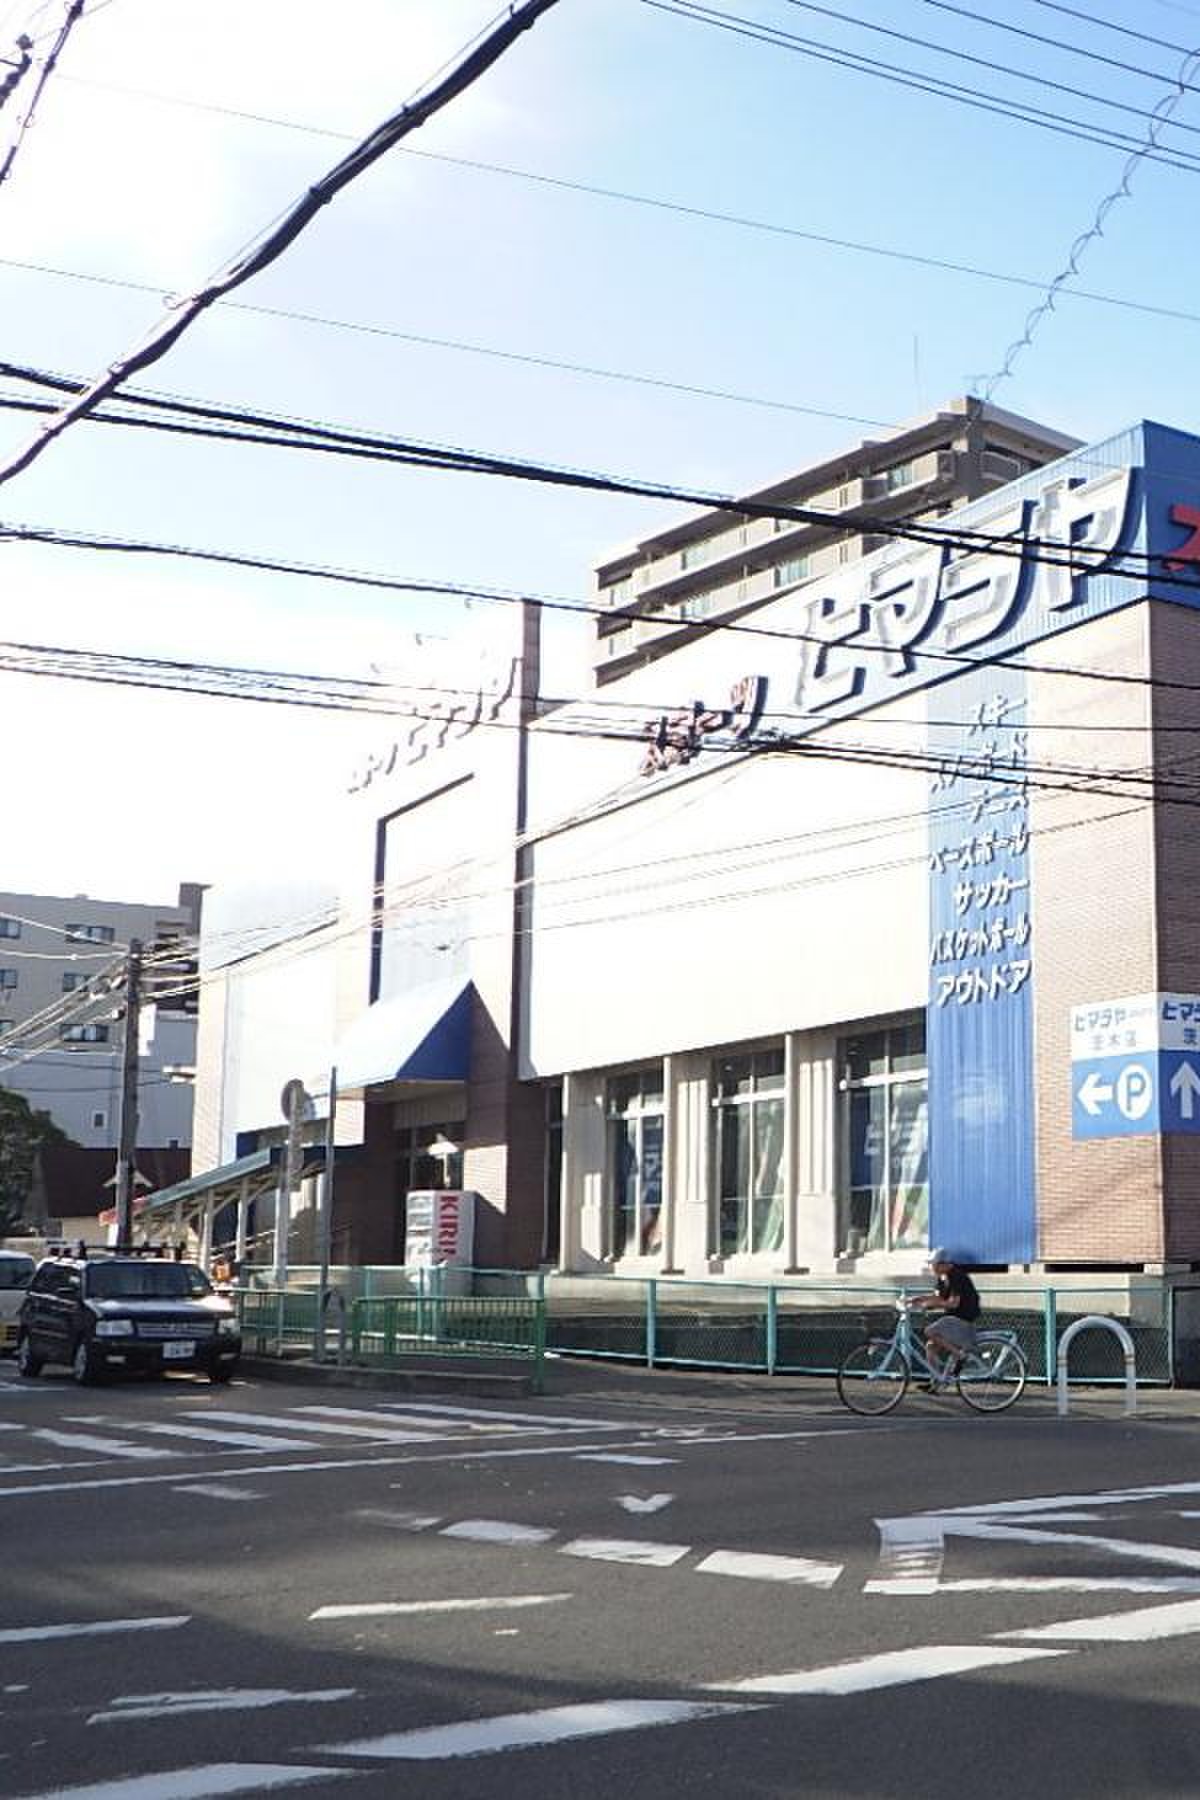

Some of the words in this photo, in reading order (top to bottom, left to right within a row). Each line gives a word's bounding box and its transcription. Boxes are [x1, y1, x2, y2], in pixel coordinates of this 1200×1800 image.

[797, 467, 1140, 713] ヒマラヤ
[953, 872, 1030, 916] サッカー
[936, 959, 1033, 1008] アウトドア
[1126, 1071, 1147, 1113] P
